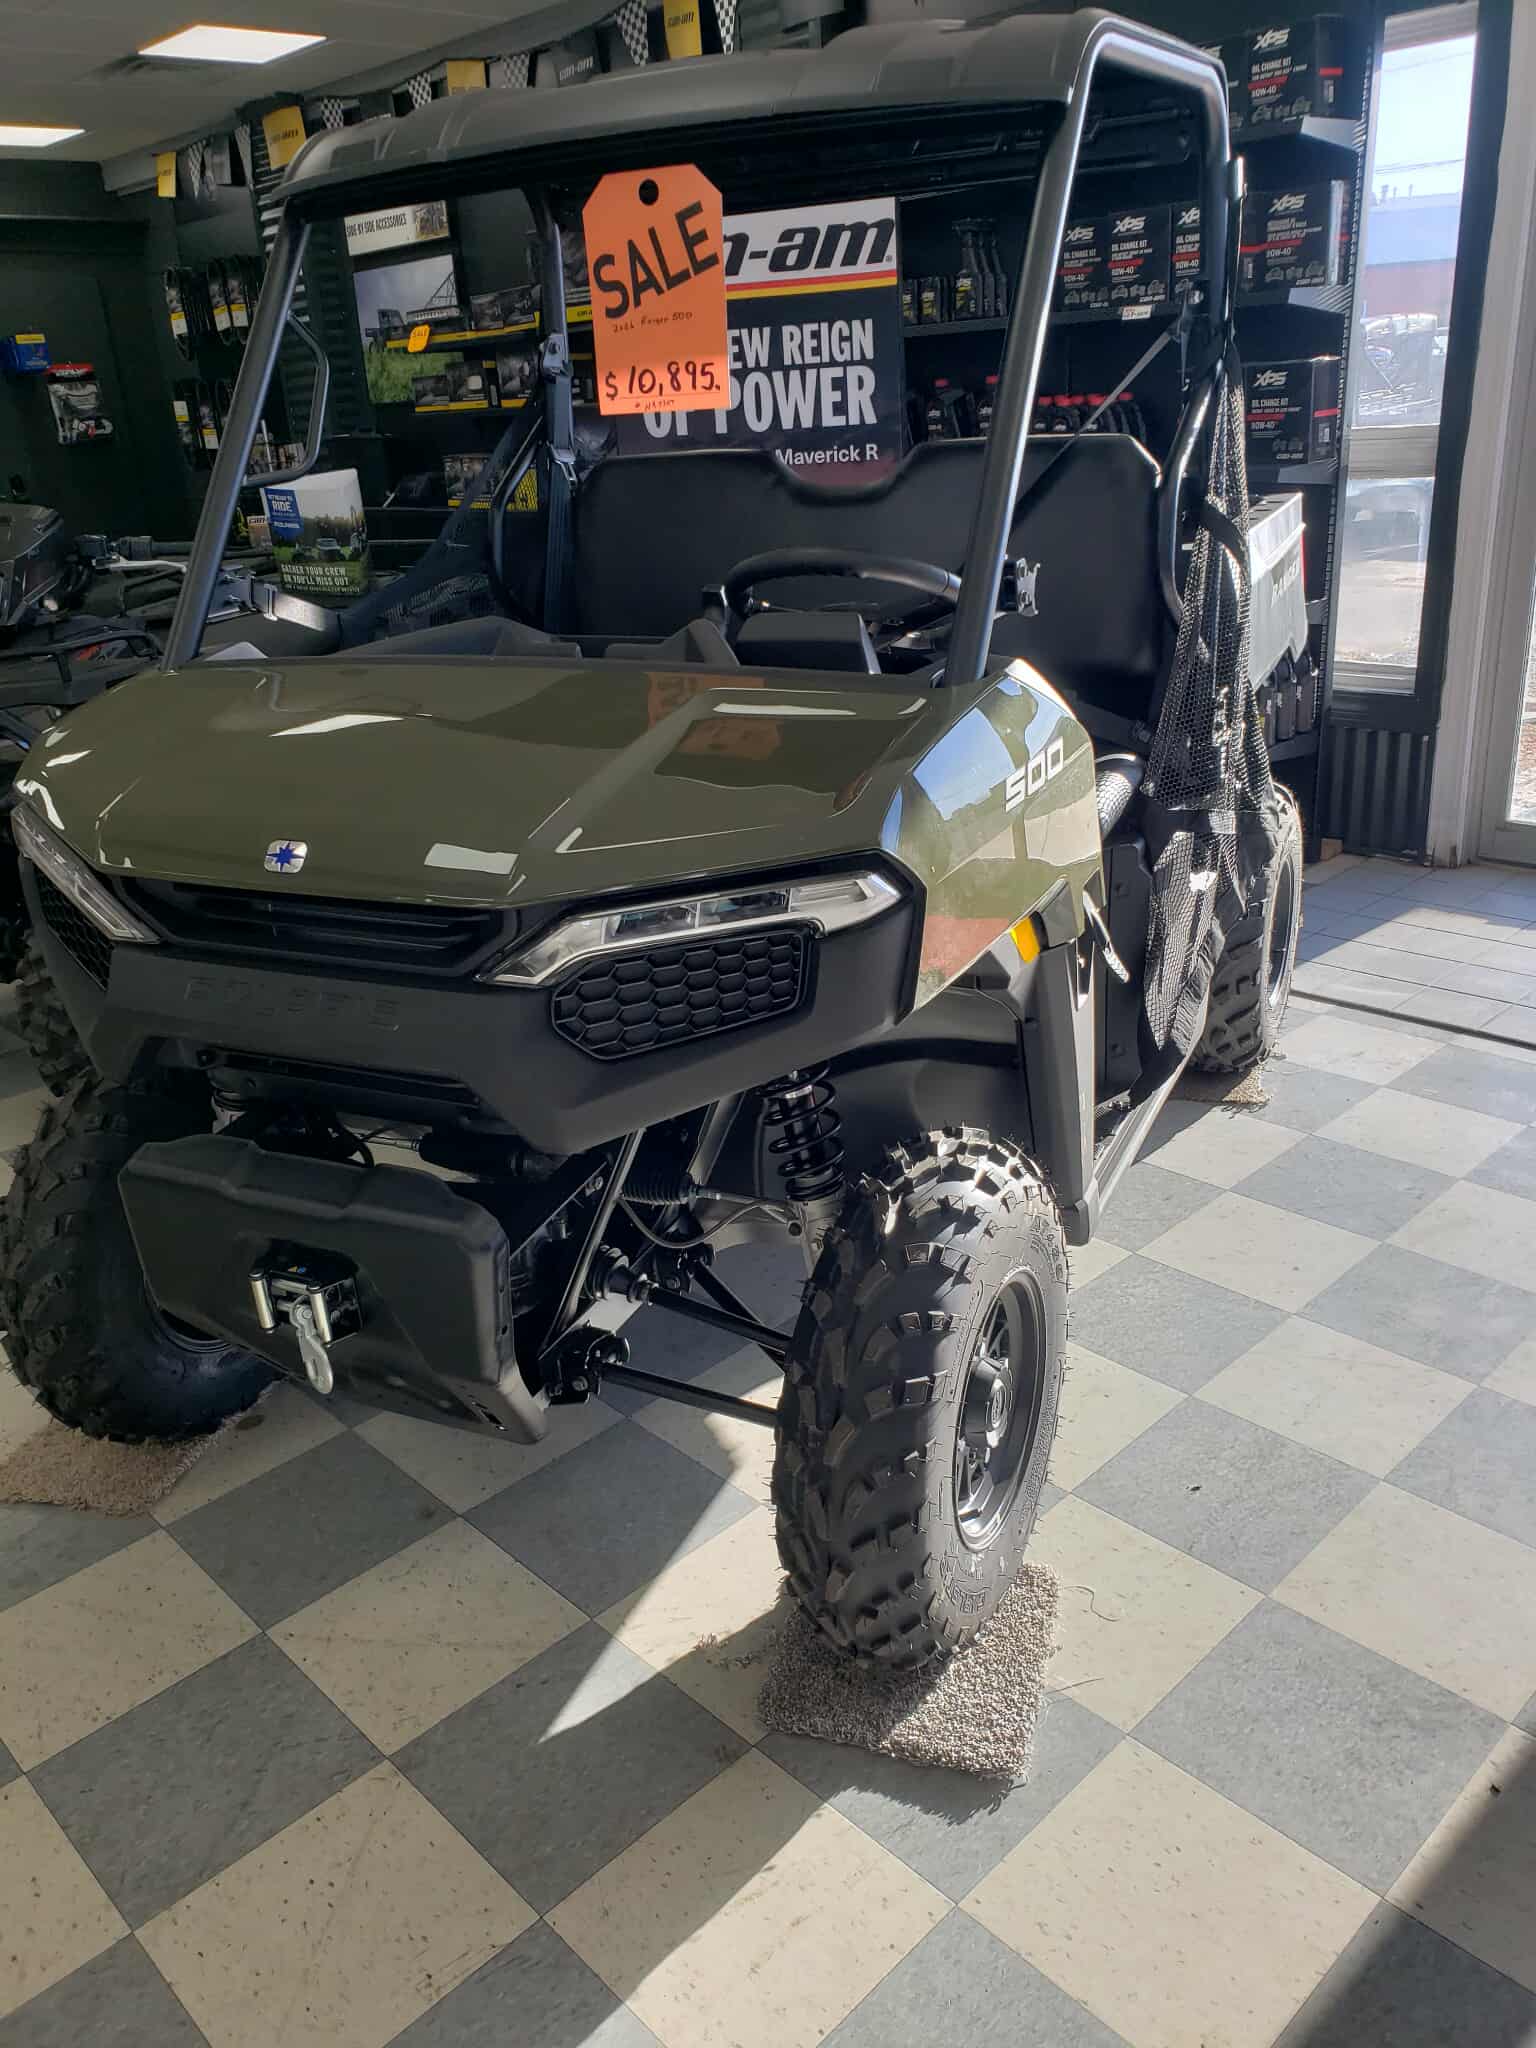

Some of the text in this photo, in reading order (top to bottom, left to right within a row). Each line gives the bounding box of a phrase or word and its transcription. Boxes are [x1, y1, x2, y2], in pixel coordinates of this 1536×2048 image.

[1253, 27, 1291, 51] XPS
[1268, 193, 1307, 214] XPS
[1112, 216, 1146, 234] XPS
[1178, 207, 1200, 225] XP
[1064, 226, 1096, 242] XPS
[722, 218, 894, 277] n-am
[593, 200, 720, 319] SALE
[727, 319, 874, 370] EW REIGN
[1252, 370, 1289, 387] XPS
[775, 443, 879, 465] Maverick R
[271, 501, 293, 512] RIDE
[1005, 735, 1064, 813] 500
